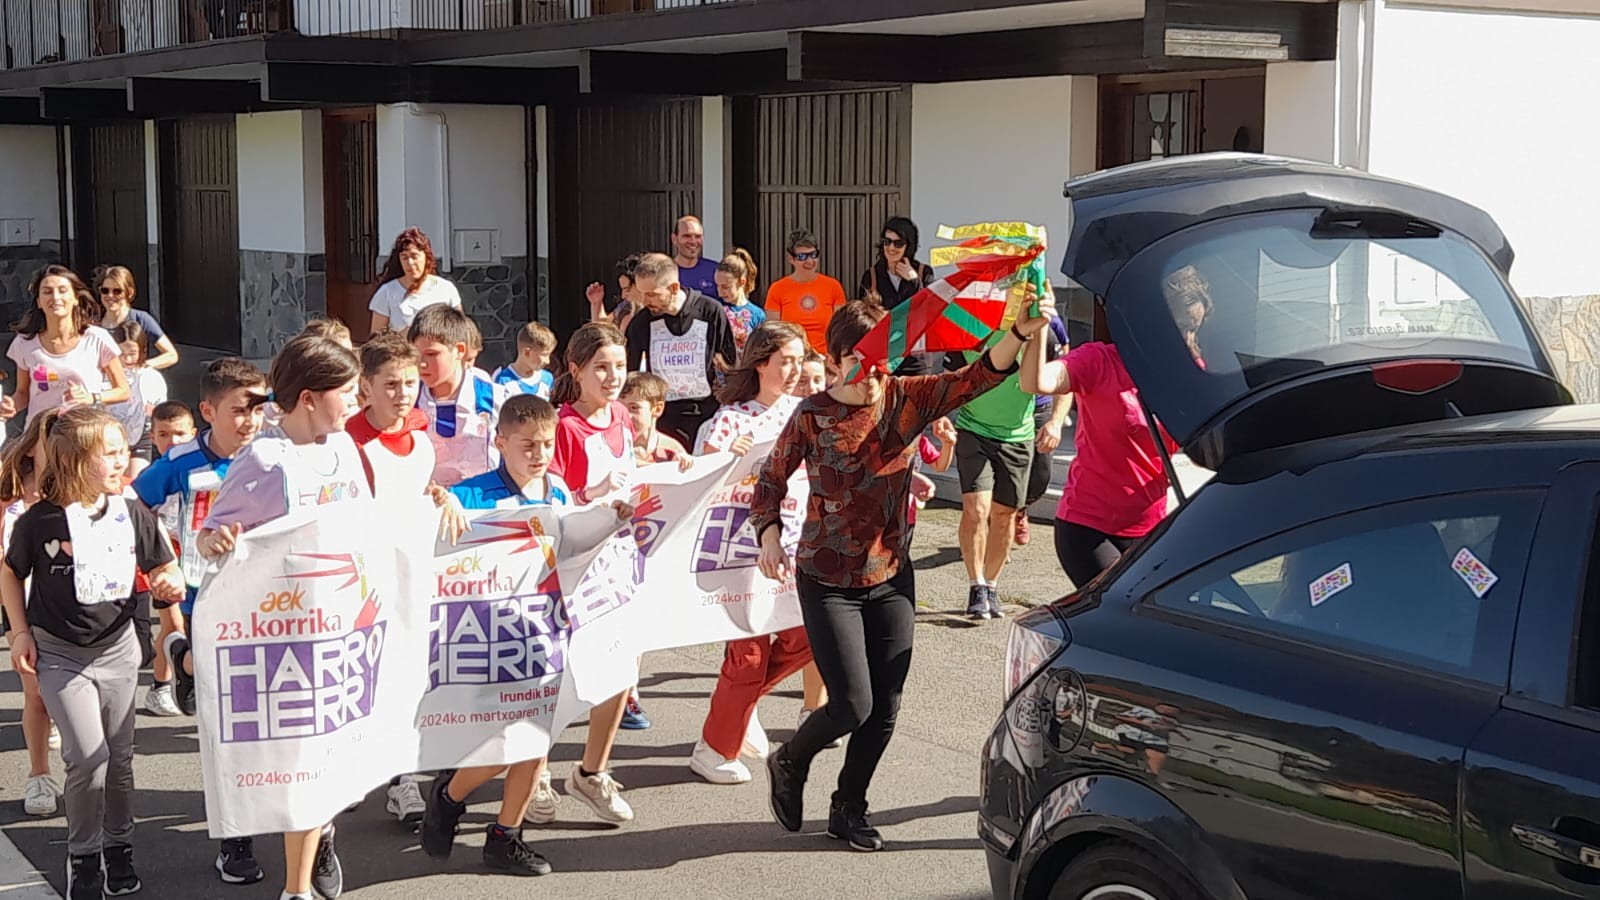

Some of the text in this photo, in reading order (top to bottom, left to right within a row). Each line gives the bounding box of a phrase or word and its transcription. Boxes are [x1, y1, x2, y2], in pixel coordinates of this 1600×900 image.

[661, 341, 698, 354] HARRO
[664, 352, 694, 366] HERRI
[446, 551, 483, 575] aek
[259, 582, 306, 613] aek
[216, 607, 342, 642] 23.korrika
[219, 624, 384, 694] HARRO
[221, 670, 376, 742] HERRI
[500, 687, 541, 703] Irundik
[421, 709, 466, 728] 2024ko
[470, 706, 539, 723] martxoaren
[236, 771, 292, 788] 2024ko
